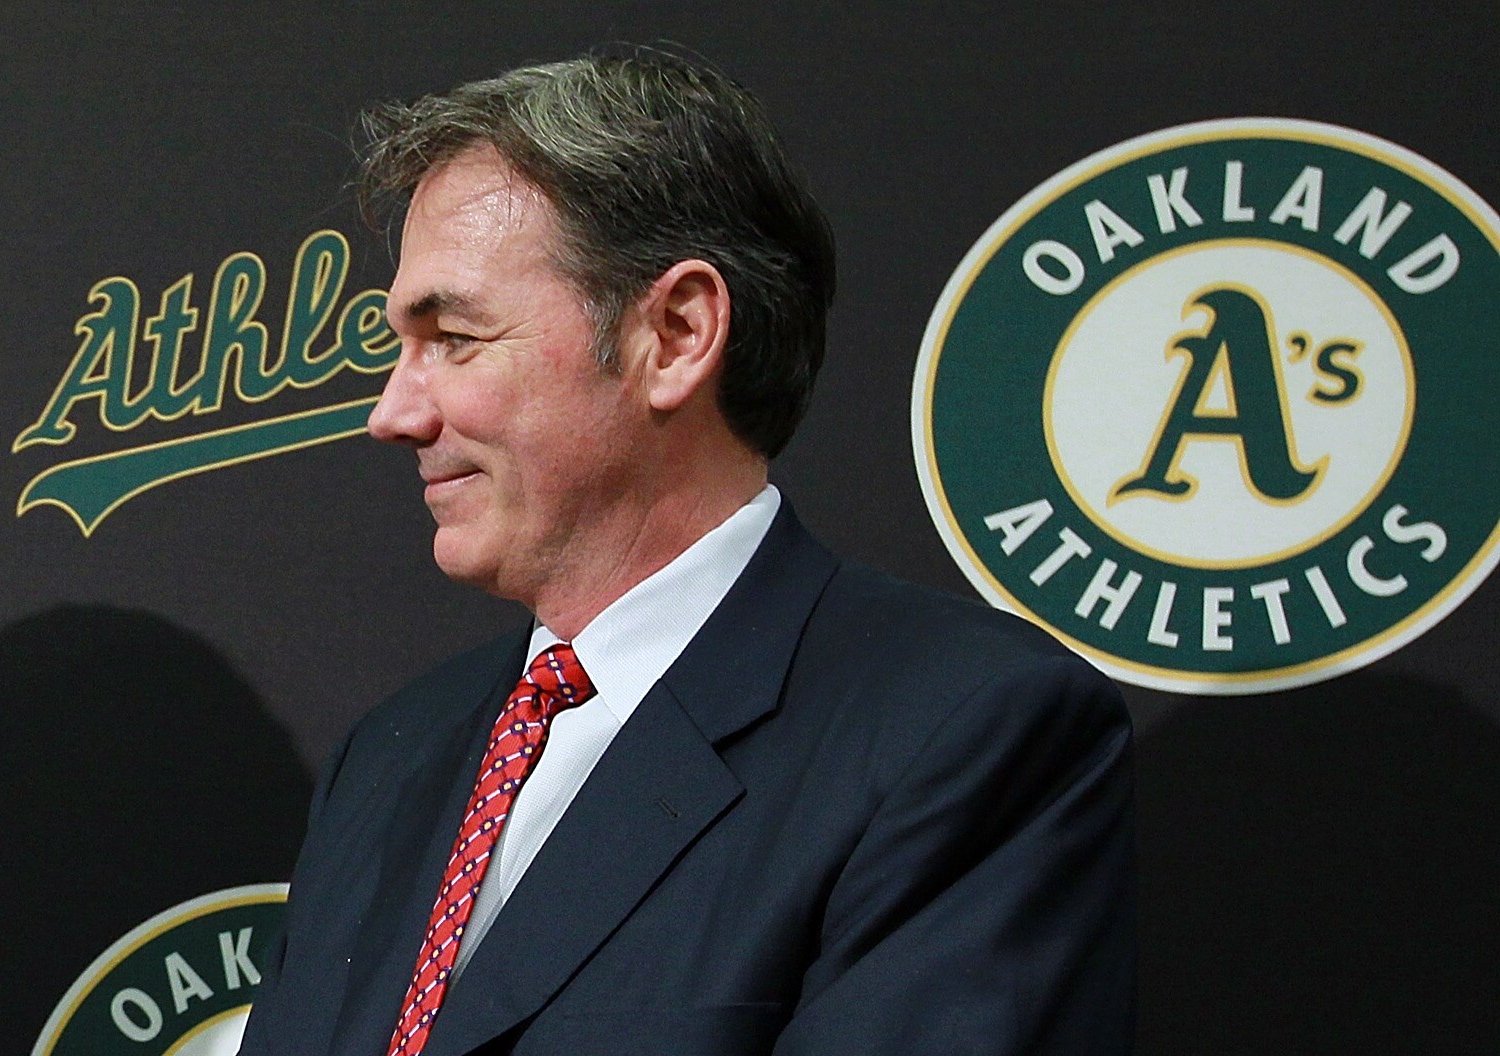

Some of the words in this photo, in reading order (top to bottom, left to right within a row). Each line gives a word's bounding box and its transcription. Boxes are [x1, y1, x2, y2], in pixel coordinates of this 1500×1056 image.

[1021, 160, 1461, 295] OAKLAND
[983, 498, 1449, 652] ATHLETICS
[110, 926, 263, 1043] OAK
